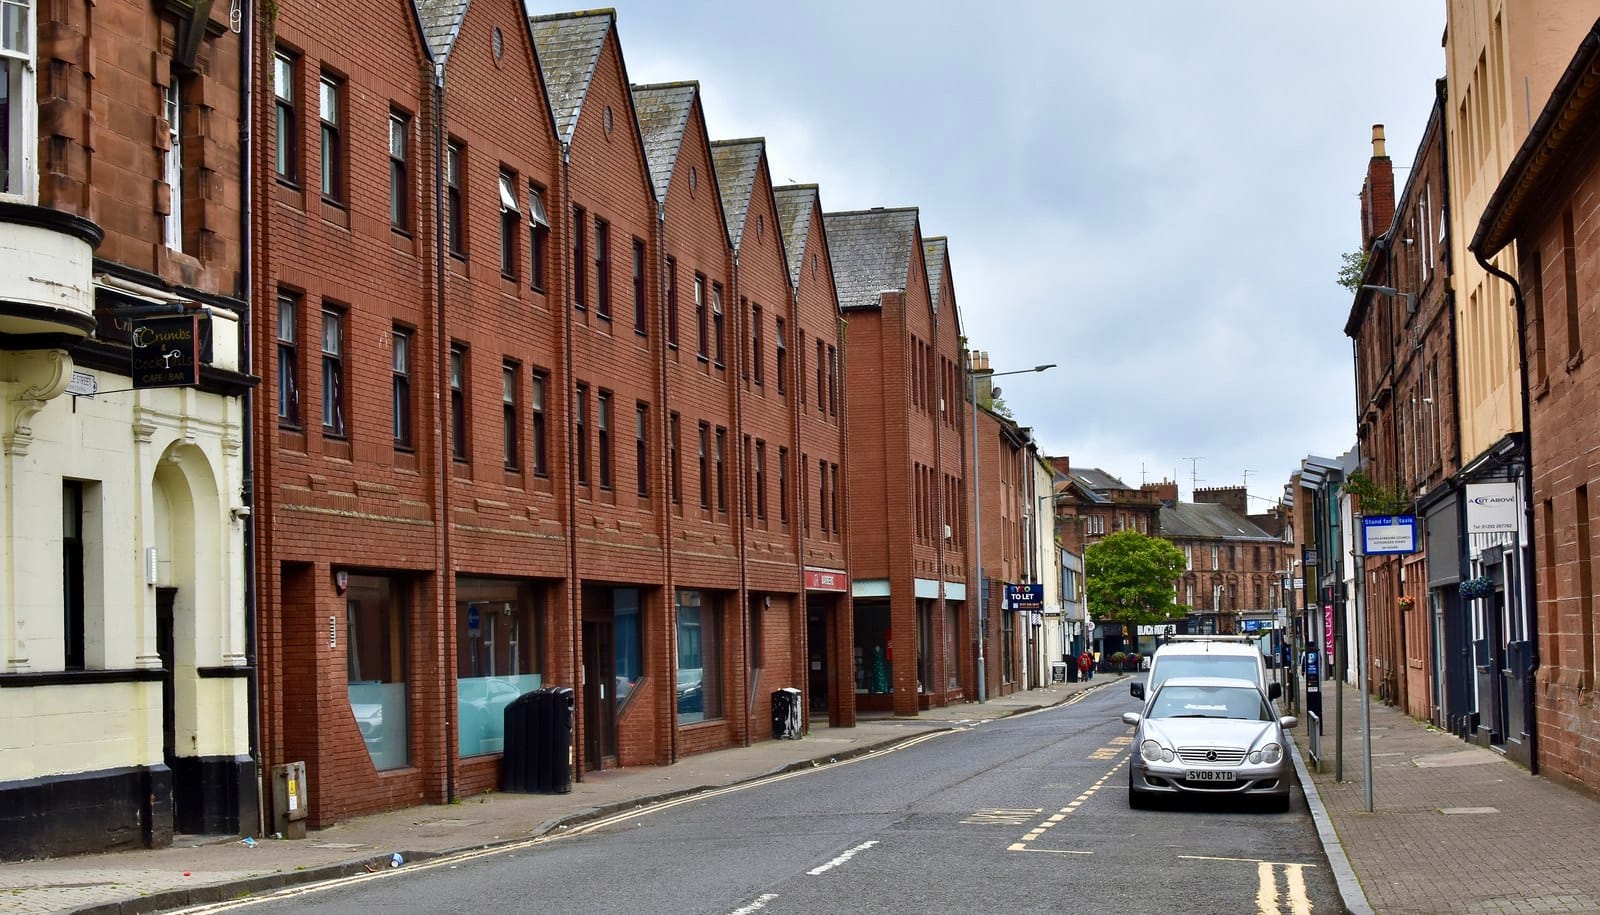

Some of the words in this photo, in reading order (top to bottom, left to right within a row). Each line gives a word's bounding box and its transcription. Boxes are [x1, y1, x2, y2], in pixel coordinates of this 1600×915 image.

[140, 327, 191, 345] Crumbs
[1190, 771, 1214, 780] SV08
[1215, 771, 1233, 780] XTD
